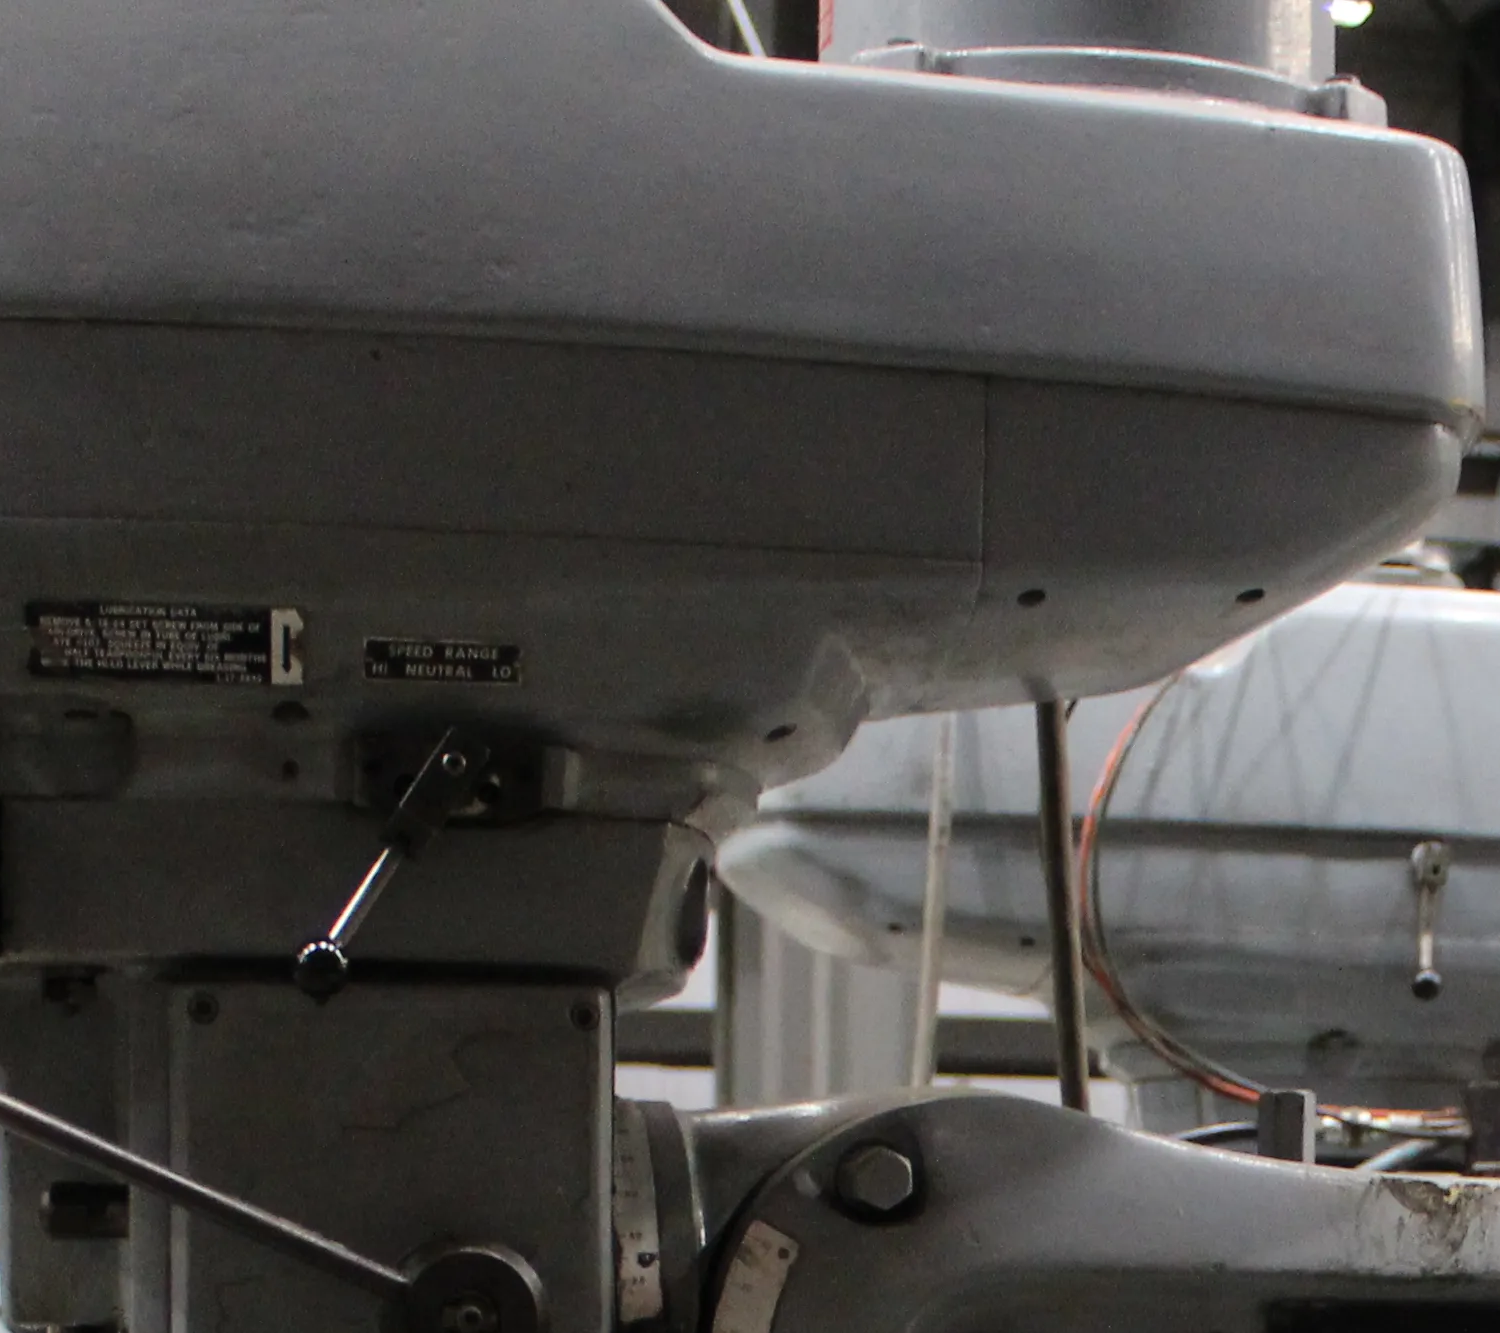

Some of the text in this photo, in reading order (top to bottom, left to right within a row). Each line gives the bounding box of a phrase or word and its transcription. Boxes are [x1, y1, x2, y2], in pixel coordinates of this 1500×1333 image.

[388, 643, 499, 661] SPEED RANGE
[371, 661, 512, 679] HI NEUTRAL LO
